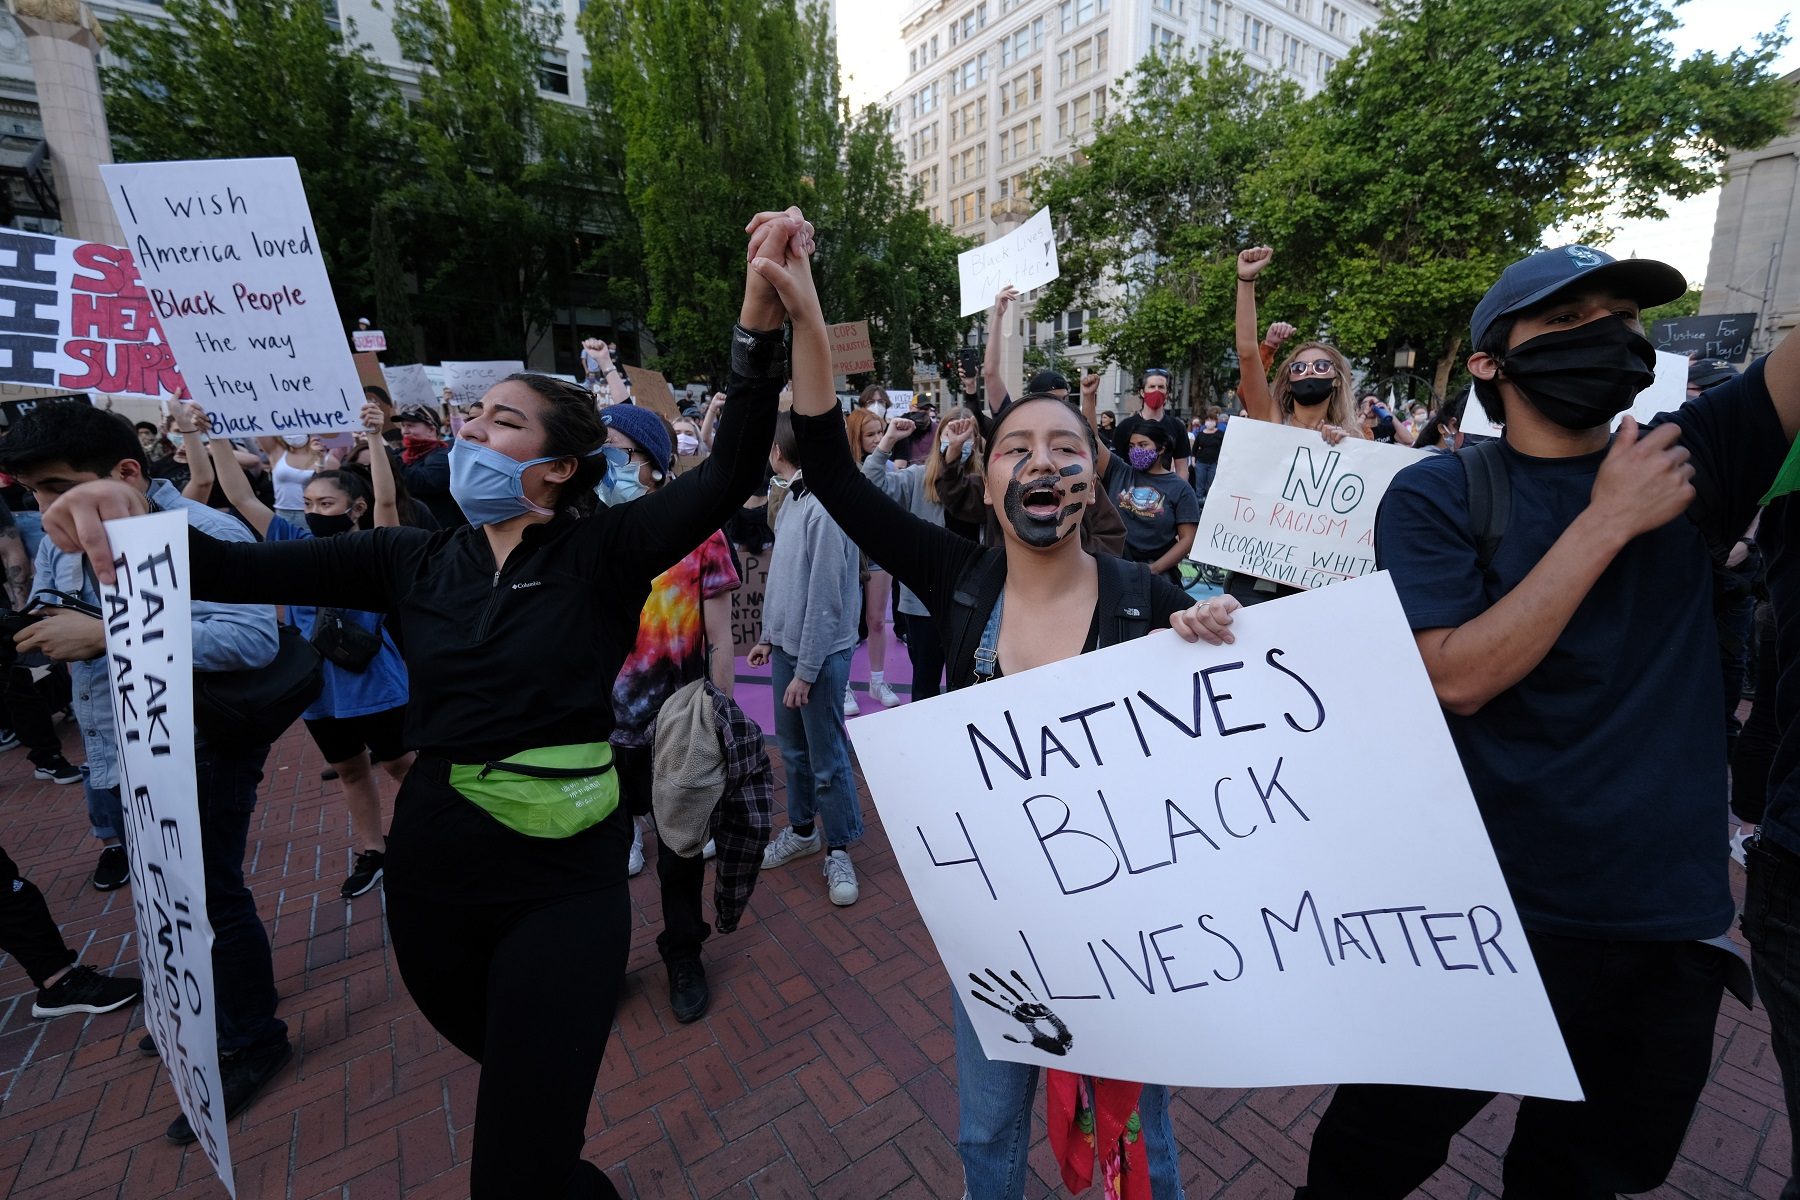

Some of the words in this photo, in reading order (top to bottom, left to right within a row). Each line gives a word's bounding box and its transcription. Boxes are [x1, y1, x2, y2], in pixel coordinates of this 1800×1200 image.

[120, 184, 138, 224] I
[164, 186, 247, 218] wish
[71, 243, 149, 299] SE
[136, 234, 241, 273] America
[251, 226, 313, 258] loved
[970, 248, 1010, 276] Black
[1016, 227, 1044, 252] Lives
[72, 293, 168, 342] HEA
[151, 287, 226, 319] Black
[232, 282, 306, 315] People
[195, 331, 237, 353] the
[248, 334, 296, 358] way
[833, 325, 857, 338] COPS
[1658, 322, 1705, 343] Justice
[1716, 319, 1739, 337] For
[204, 374, 258, 401] they
[269, 373, 314, 393] love
[206, 411, 264, 435] Black
[270, 388, 355, 431] Culture!
[1281, 446, 1365, 514] NO
[1230, 494, 1256, 524] TO
[1269, 502, 1348, 539] RACISM
[1210, 522, 1300, 563] RECOGNIZE
[967, 648, 1327, 790] NATIVES
[134, 785, 155, 831] E
[916, 812, 998, 900] 4
[1022, 757, 1311, 896] BLACK
[160, 818, 183, 861] E
[1018, 914, 1245, 1001] LIVES
[1260, 890, 1518, 976] MATTER
